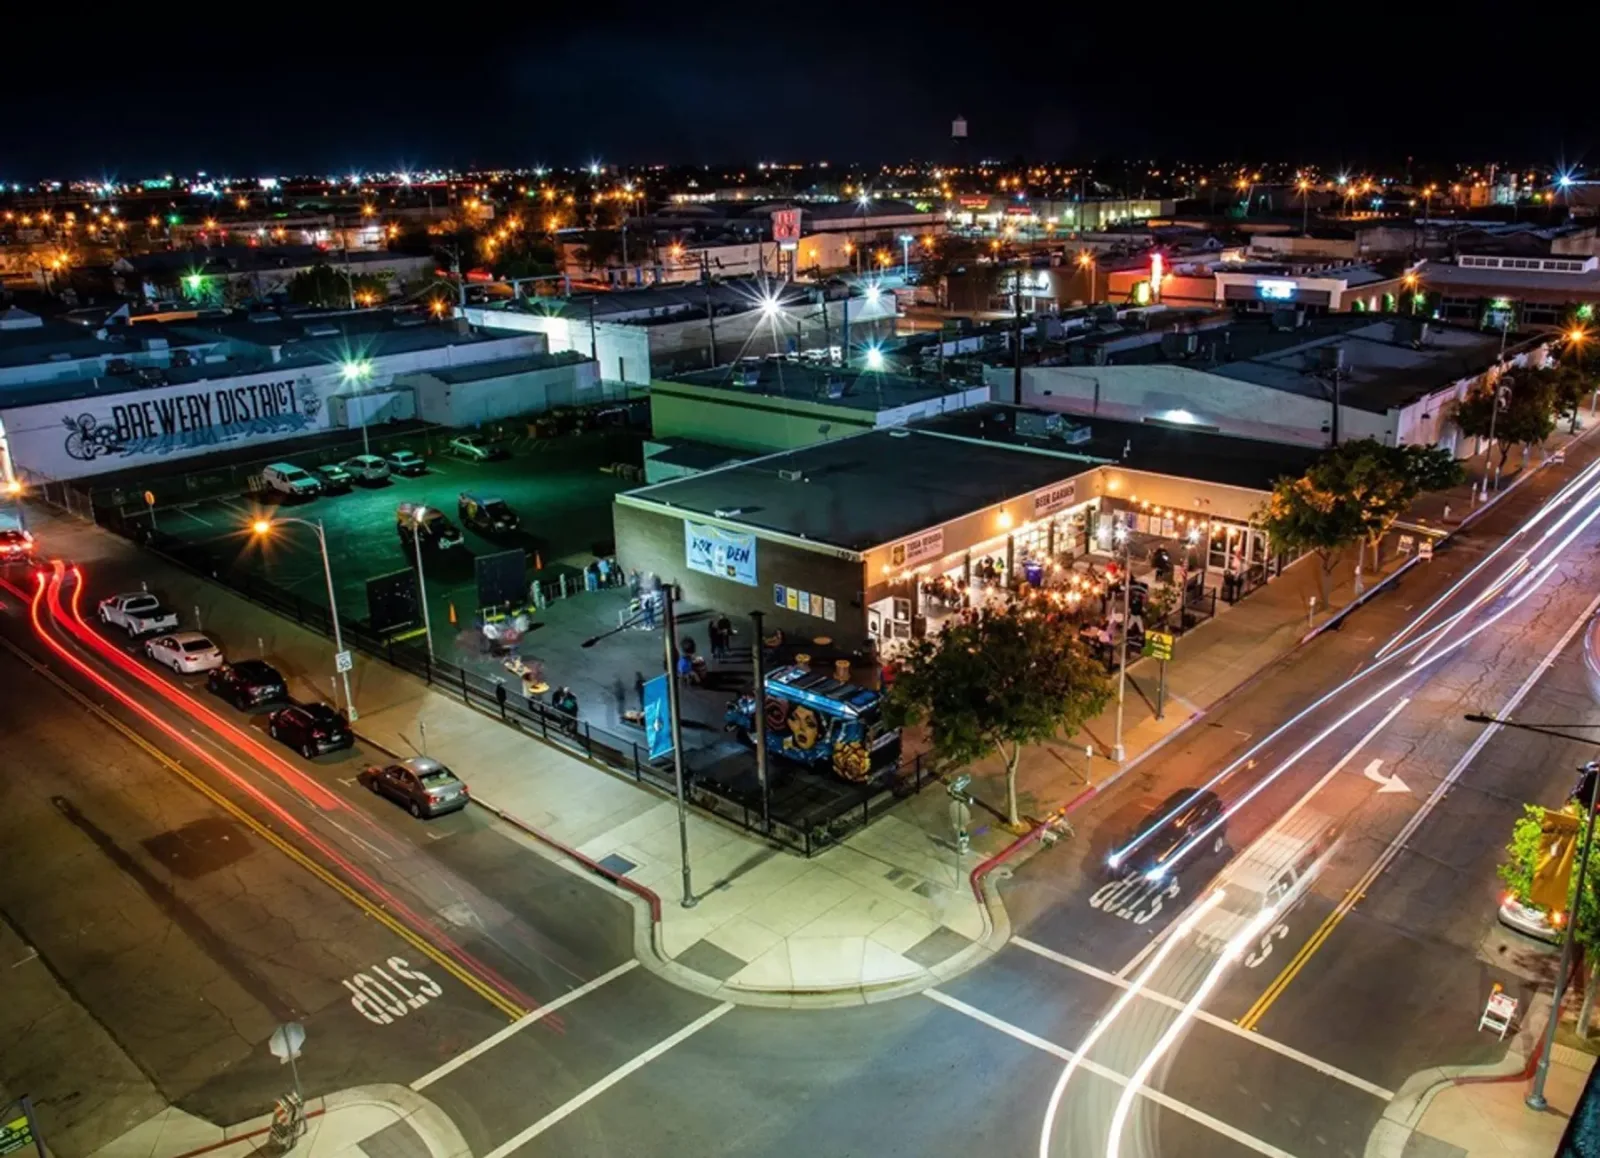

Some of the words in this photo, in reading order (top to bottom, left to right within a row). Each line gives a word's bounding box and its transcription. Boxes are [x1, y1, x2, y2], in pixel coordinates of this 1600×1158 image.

[112, 392, 212, 442] BREWERY
[217, 379, 299, 425] DISTRICT
[727, 545, 750, 564] DEN
[342, 956, 443, 1025] STOP
